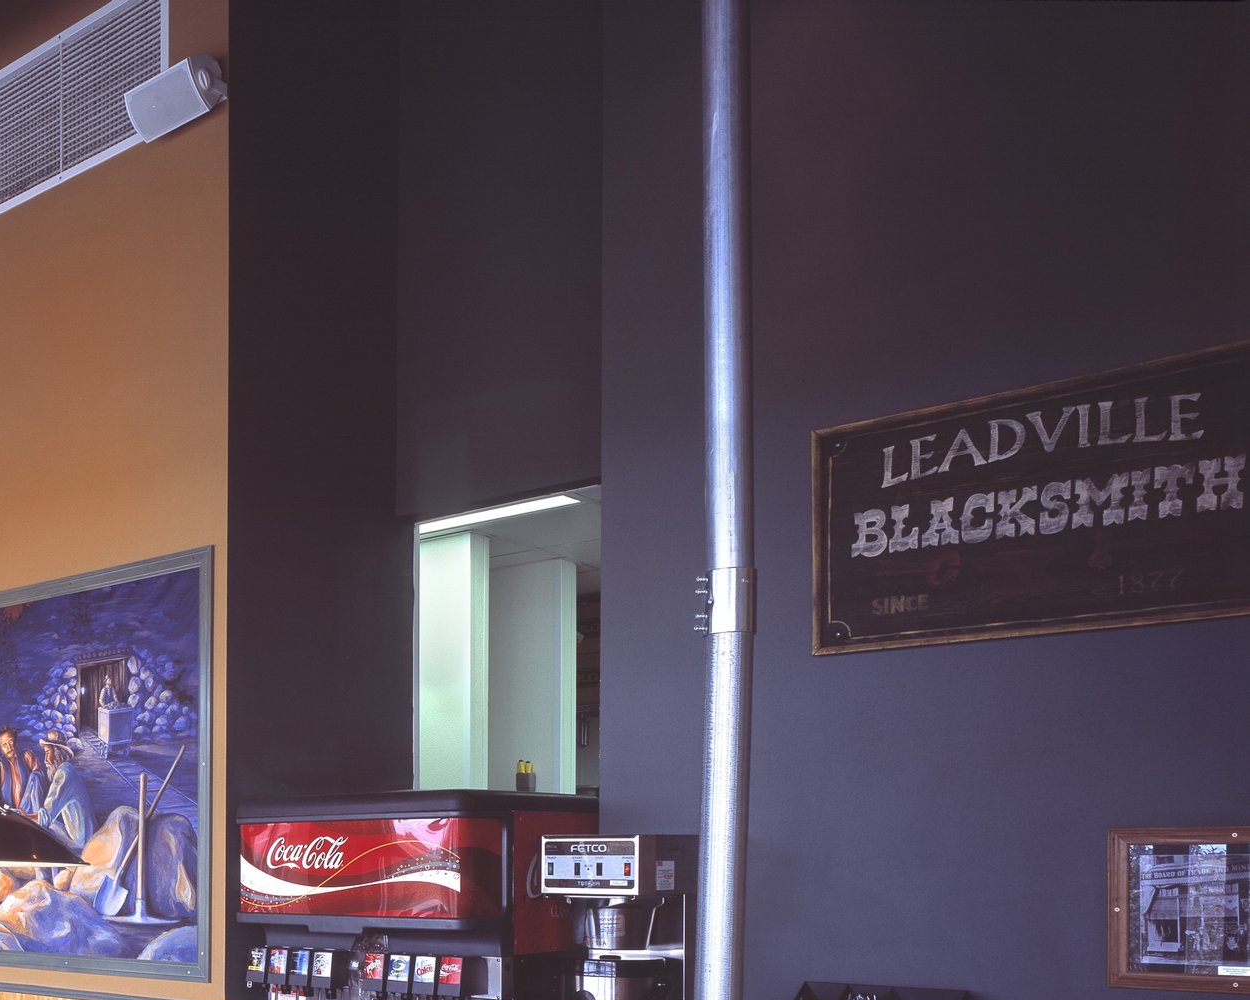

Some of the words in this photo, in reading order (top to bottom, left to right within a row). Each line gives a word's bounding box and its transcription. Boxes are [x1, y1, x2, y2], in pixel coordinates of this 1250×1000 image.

[881, 392, 1205, 489] LEADVILLE
[851, 453, 1248, 559] BLACKSMITH
[871, 593, 930, 616] SINCE
[266, 835, 349, 870] Coca-Cola
[570, 843, 607, 853] FETCO
[1154, 871, 1175, 879] BOARD
[416, 965, 434, 977] Coke
